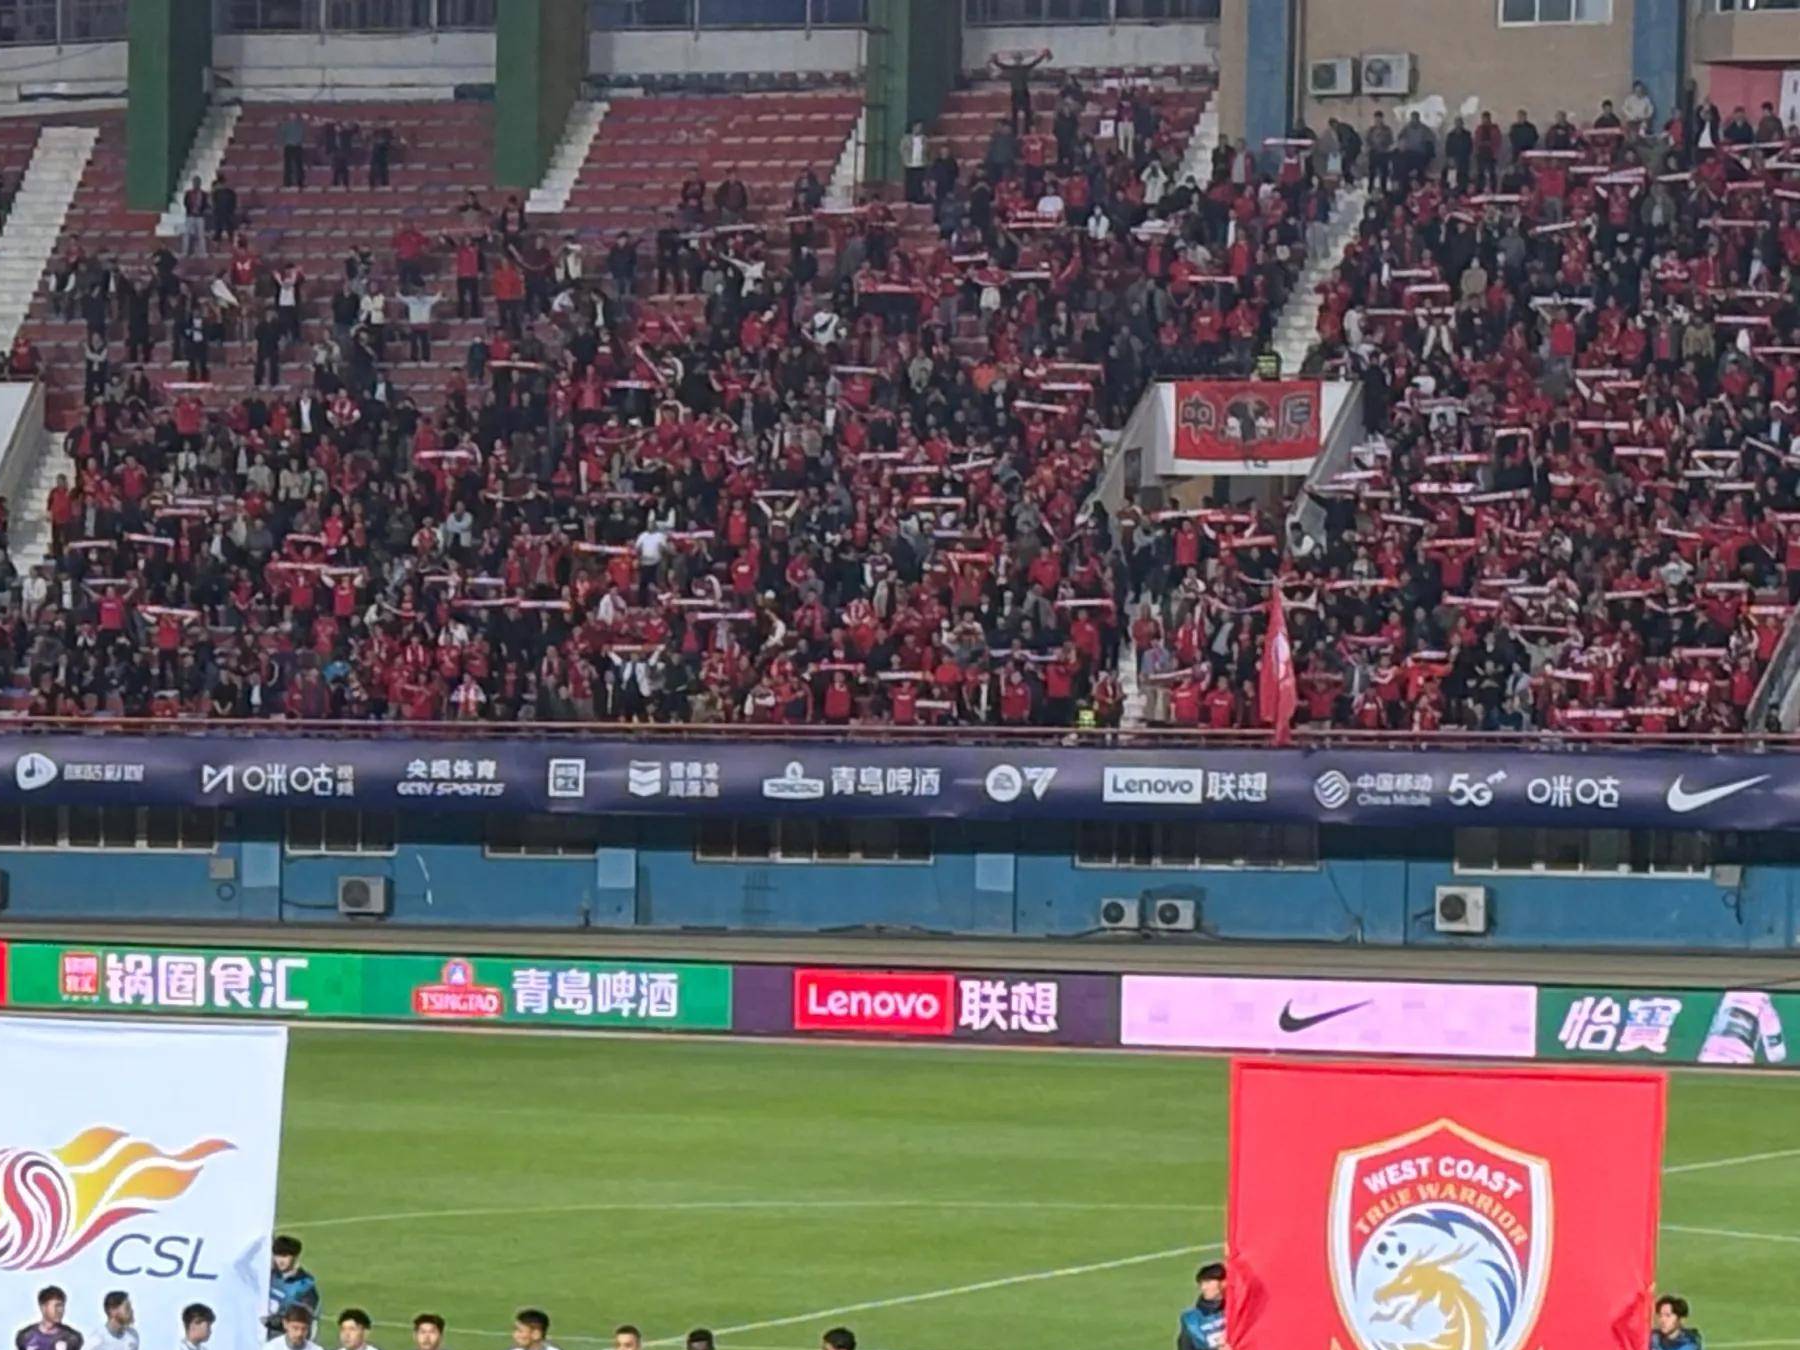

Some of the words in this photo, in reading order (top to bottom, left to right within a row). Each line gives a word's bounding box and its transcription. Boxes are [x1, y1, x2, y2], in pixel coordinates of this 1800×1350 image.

[831, 766, 942, 796] 青岛啤酒
[1112, 775, 1193, 795] Lenovo
[1207, 771, 1267, 801] 联想
[1357, 773, 1432, 792] 中国移动
[106, 953, 309, 1010] 锅圈食汇
[512, 968, 678, 1019] 青岛啤酒
[419, 992, 499, 1014] TSINGTAO
[808, 984, 940, 1018] Lenovo
[959, 980, 1058, 1032] 联想
[1363, 1157, 1431, 1195] WEST
[1438, 1157, 1524, 1200] COAST
[1355, 1184, 1414, 1236] TRUE
[1417, 1182, 1529, 1245] WARRIOR
[106, 1233, 219, 1280] CSL
